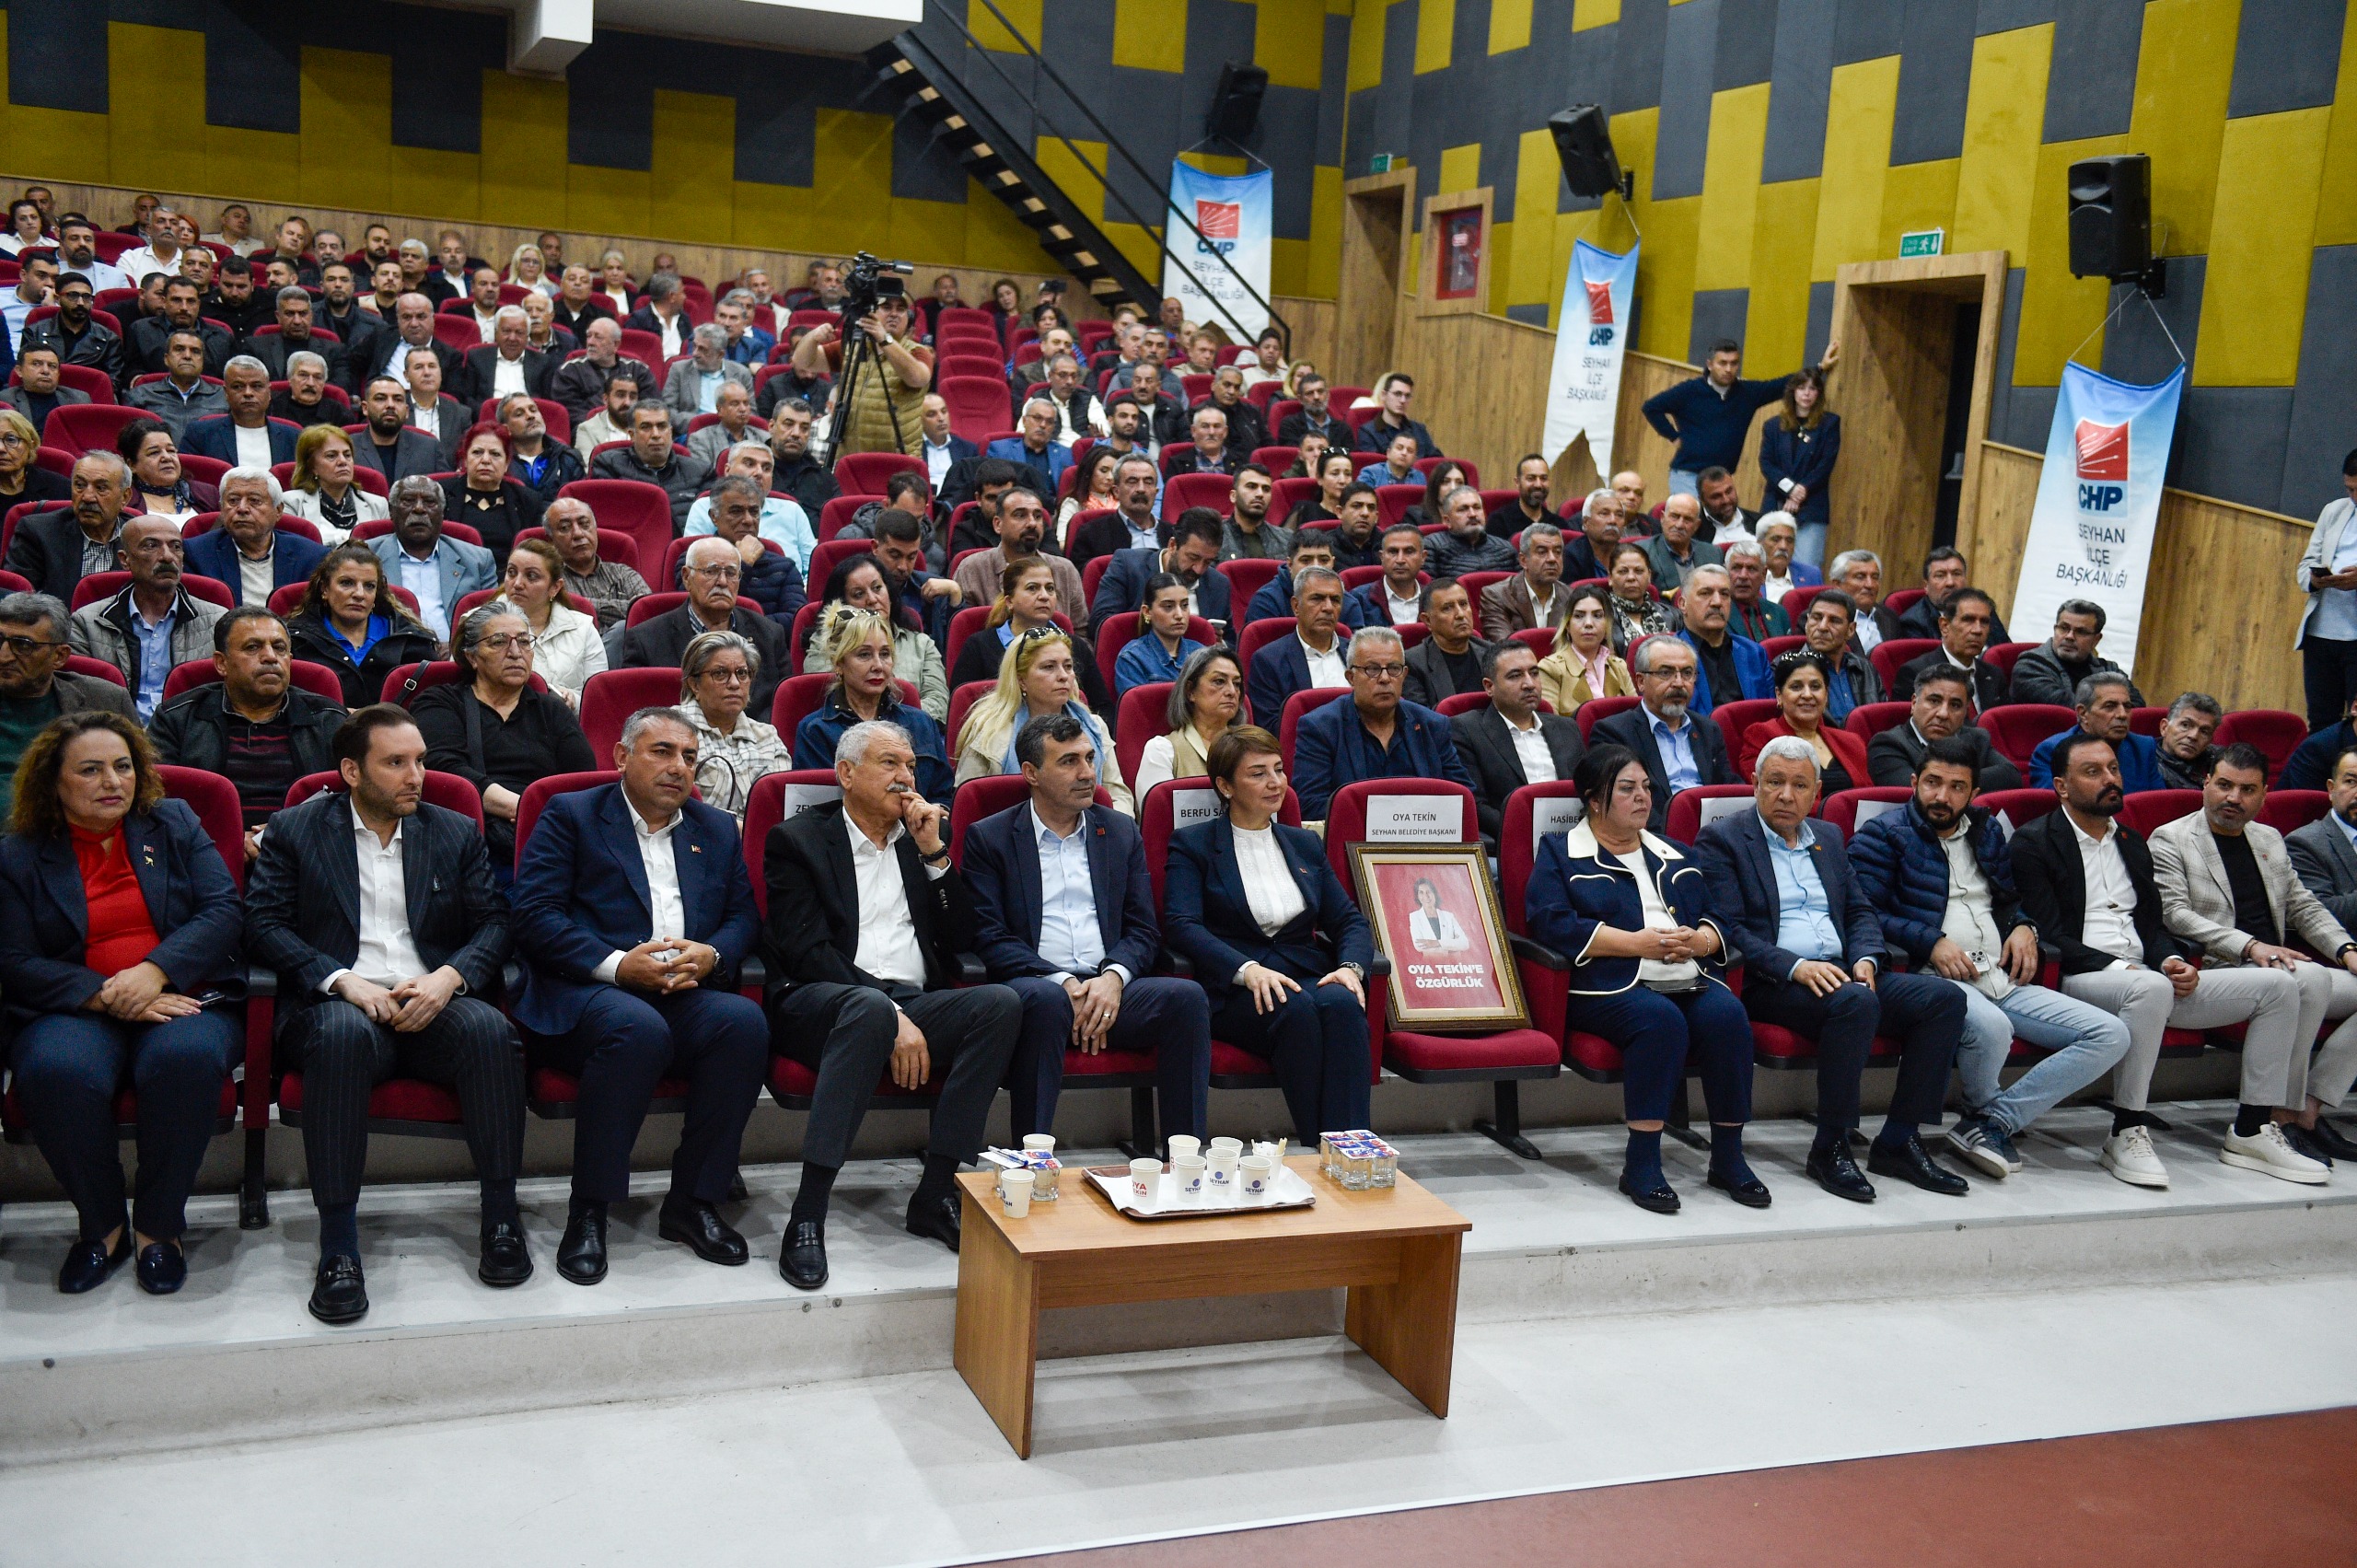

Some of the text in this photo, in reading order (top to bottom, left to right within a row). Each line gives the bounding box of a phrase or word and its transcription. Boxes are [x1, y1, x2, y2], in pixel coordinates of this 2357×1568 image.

[1589, 328, 1613, 346] CHP
[2078, 483, 2123, 511] CHP
[2078, 522, 2125, 543] SEYHAN
[2085, 543, 2110, 567] İLÇE
[2056, 563, 2129, 589] BAŞKANLIĞI
[1180, 808, 1211, 818] BERFU
[1392, 811, 1436, 821] OYA TEKİN
[1550, 814, 1579, 823] HASİBE
[1398, 828, 1427, 836] BELEDİYE
[1428, 828, 1457, 837] BAŞKANI
[1407, 962, 1484, 975] OYA TEKİN'E
[1415, 976, 1484, 989] ÖZGÜRLÜK
